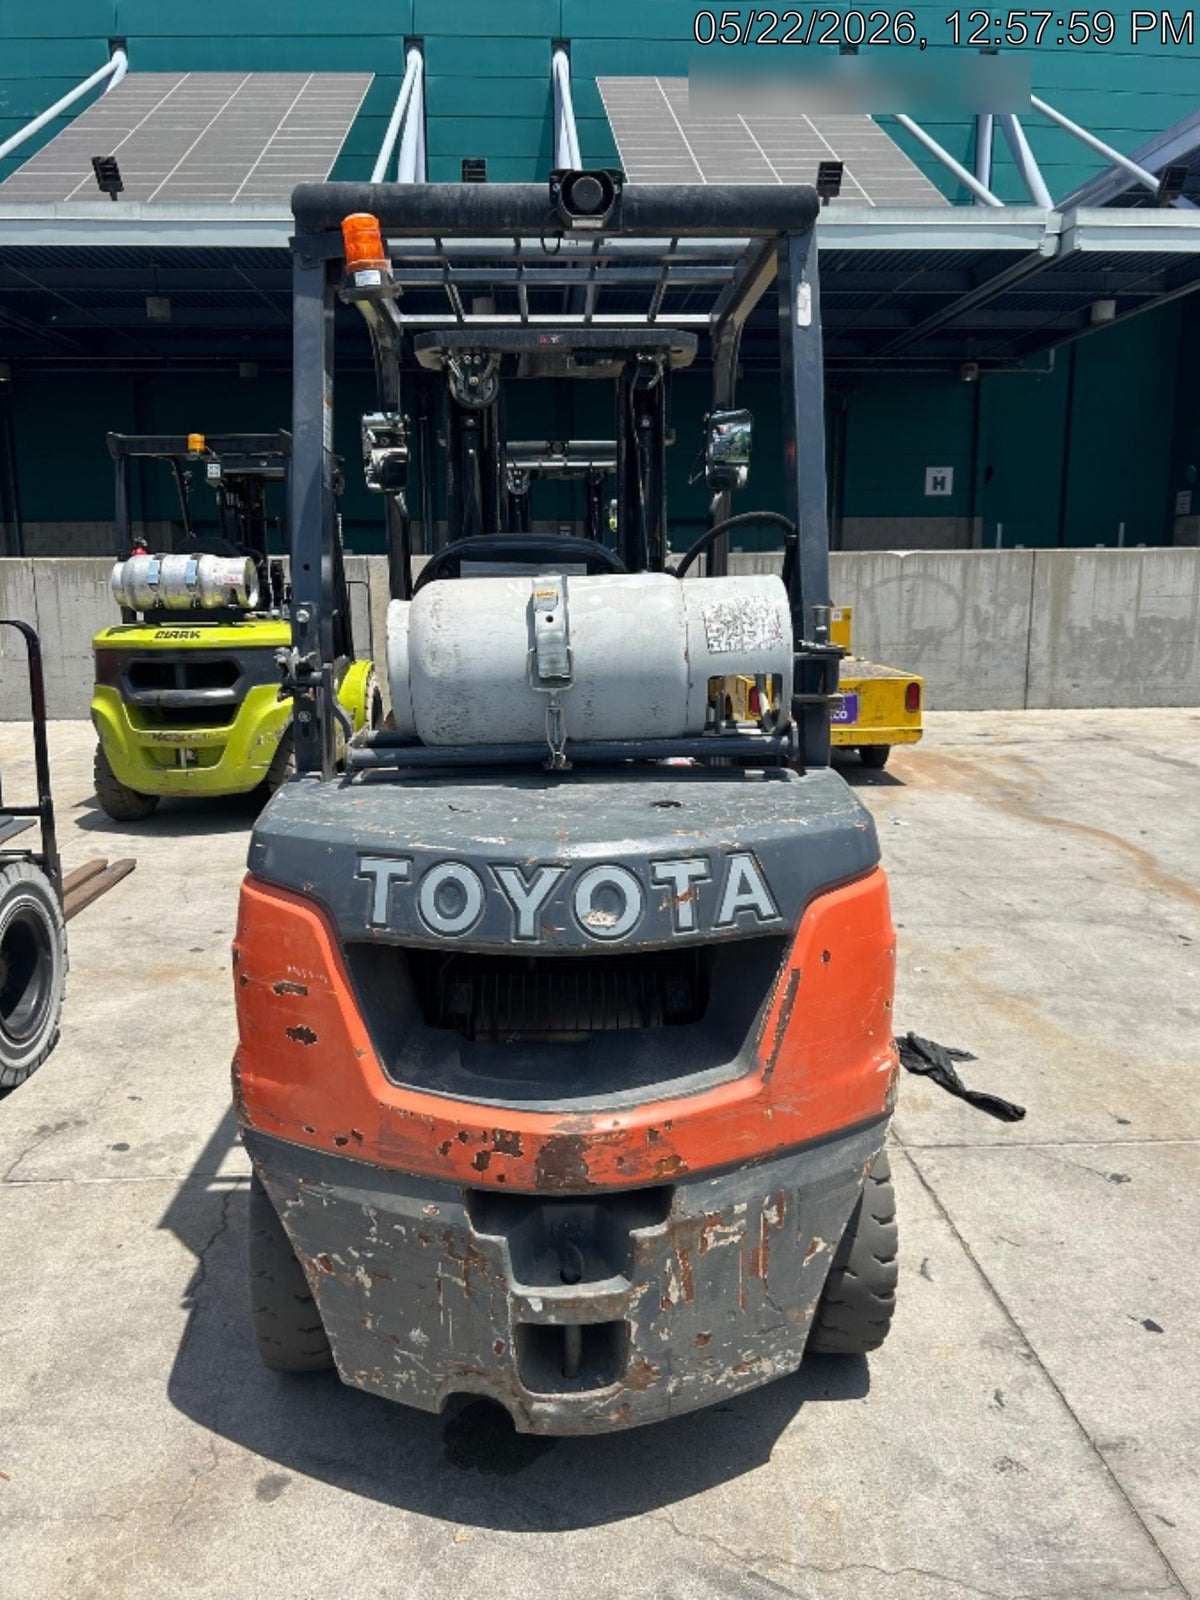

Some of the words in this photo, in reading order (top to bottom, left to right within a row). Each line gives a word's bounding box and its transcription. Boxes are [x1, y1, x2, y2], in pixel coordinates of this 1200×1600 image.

[932, 476, 946, 491] H
[154, 630, 201, 639] CLARK
[355, 851, 781, 942] TOYOTA
